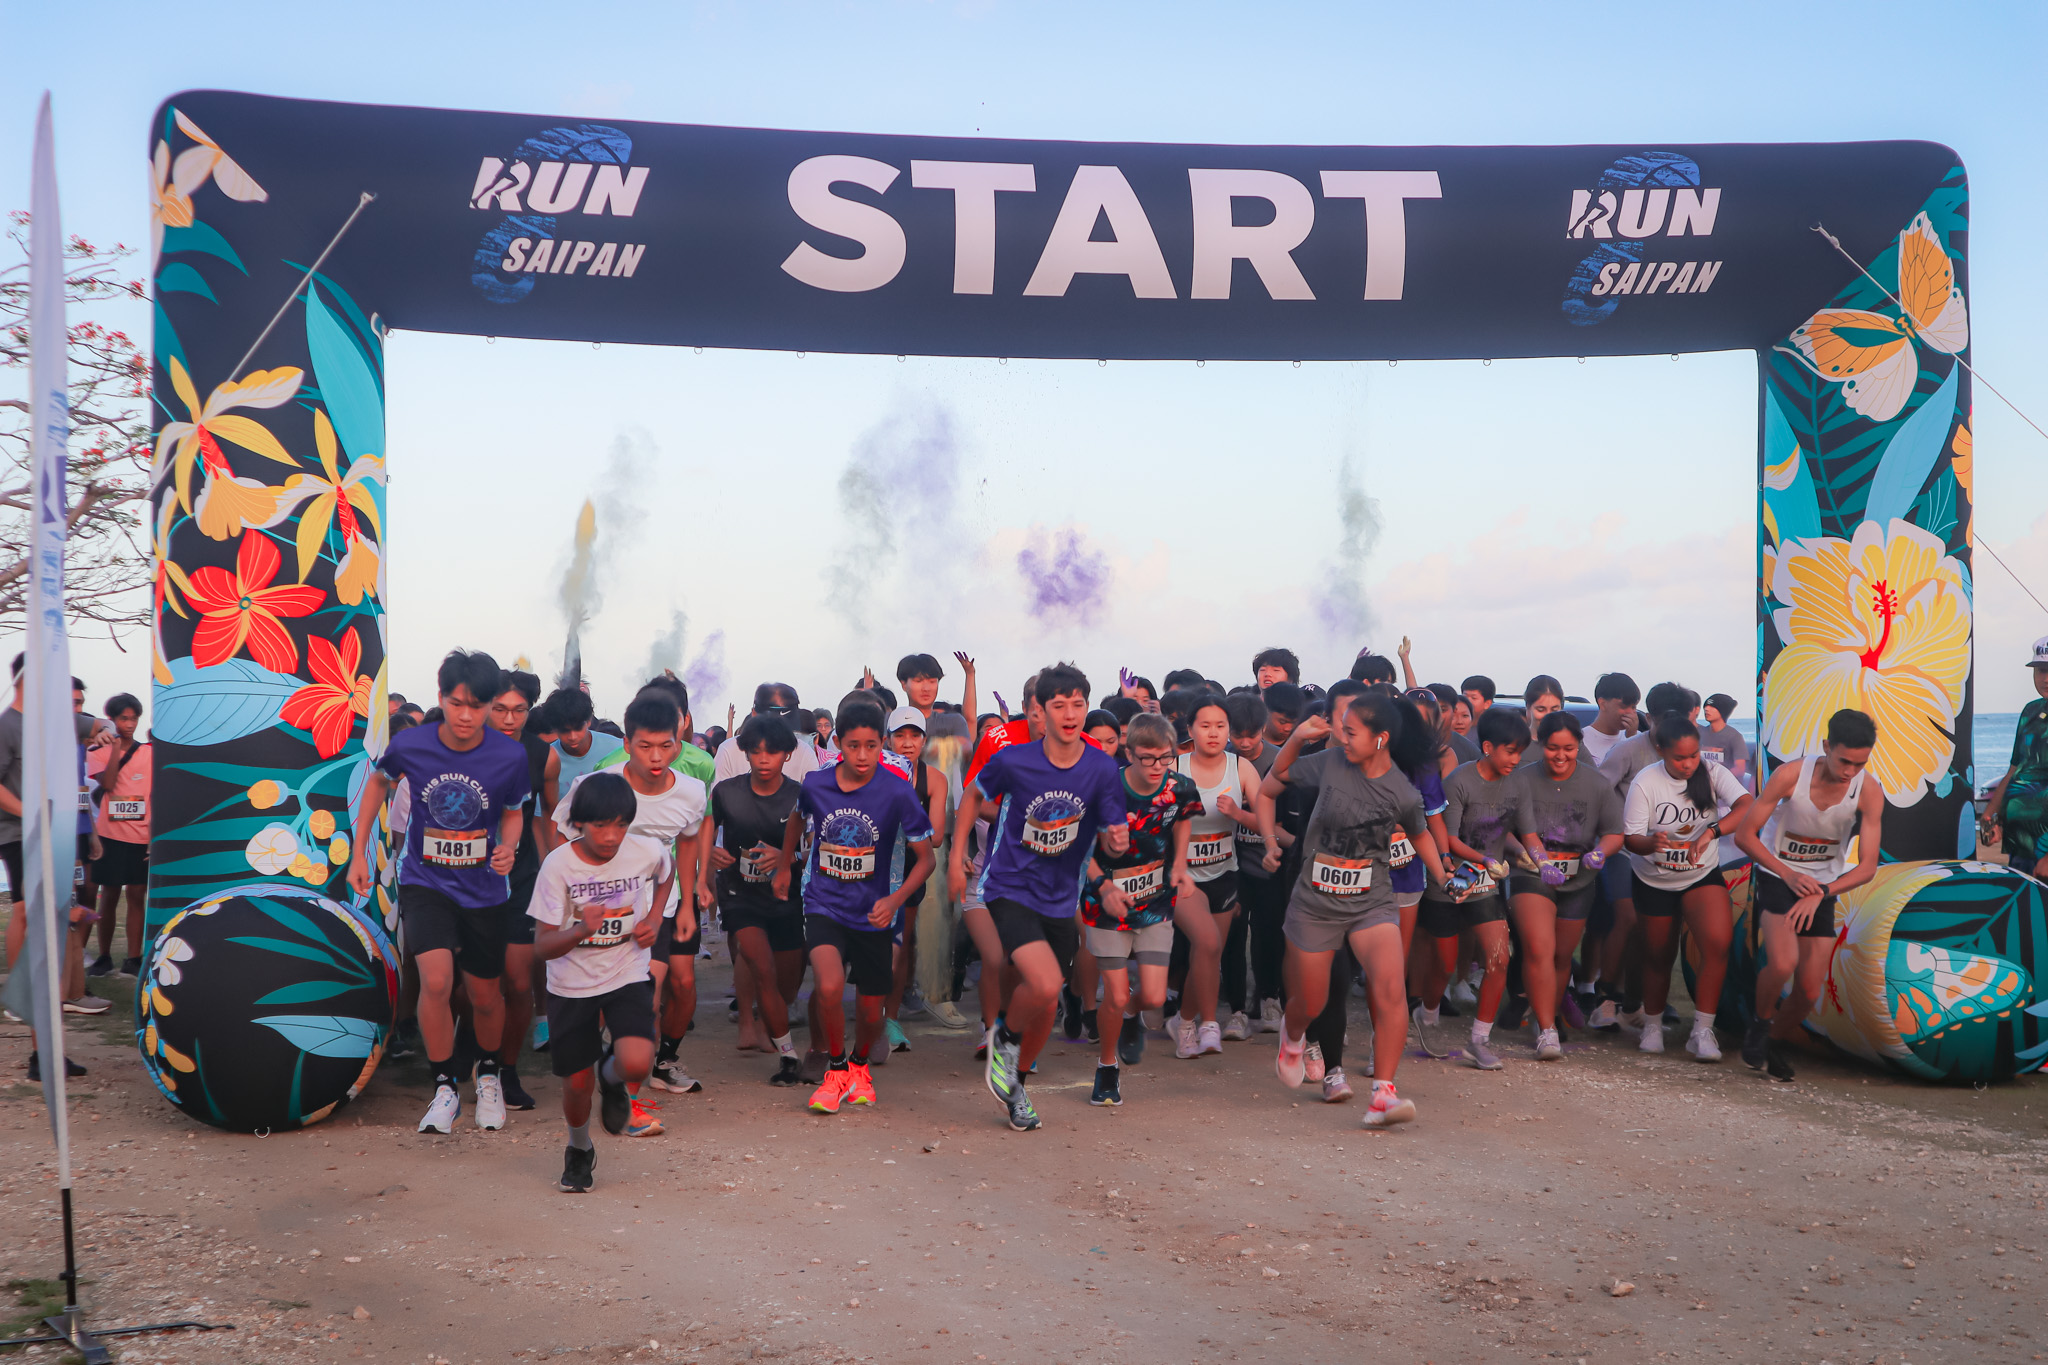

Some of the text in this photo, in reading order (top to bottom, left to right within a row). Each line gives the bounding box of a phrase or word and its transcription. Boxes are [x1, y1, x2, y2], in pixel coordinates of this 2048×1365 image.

[469, 156, 650, 217] RUN
[1566, 188, 1722, 239] RUN
[780, 154, 1443, 300] START
[502, 237, 646, 278] SAIPAN
[1591, 261, 1723, 296] SAIPAN
[421, 773, 489, 810] MHS RUN CLUB
[1044, 790, 1073, 800] RUN
[115, 803, 138, 813] 1025
[820, 808, 880, 842] MHS RUN CLUB
[1031, 828, 1068, 846] 1435
[434, 840, 472, 857] 1481
[1193, 841, 1221, 857] 1471
[1389, 842, 1408, 860] 31
[431, 857, 478, 866] RUN SAIPAN
[827, 854, 863, 872] 1488
[825, 868, 866, 880] RUN SAIPAN
[1122, 872, 1154, 894] 1034
[1320, 866, 1361, 886] 0607
[567, 876, 640, 899] EPRESENT
[1318, 884, 1362, 895] RUN SAIPAN
